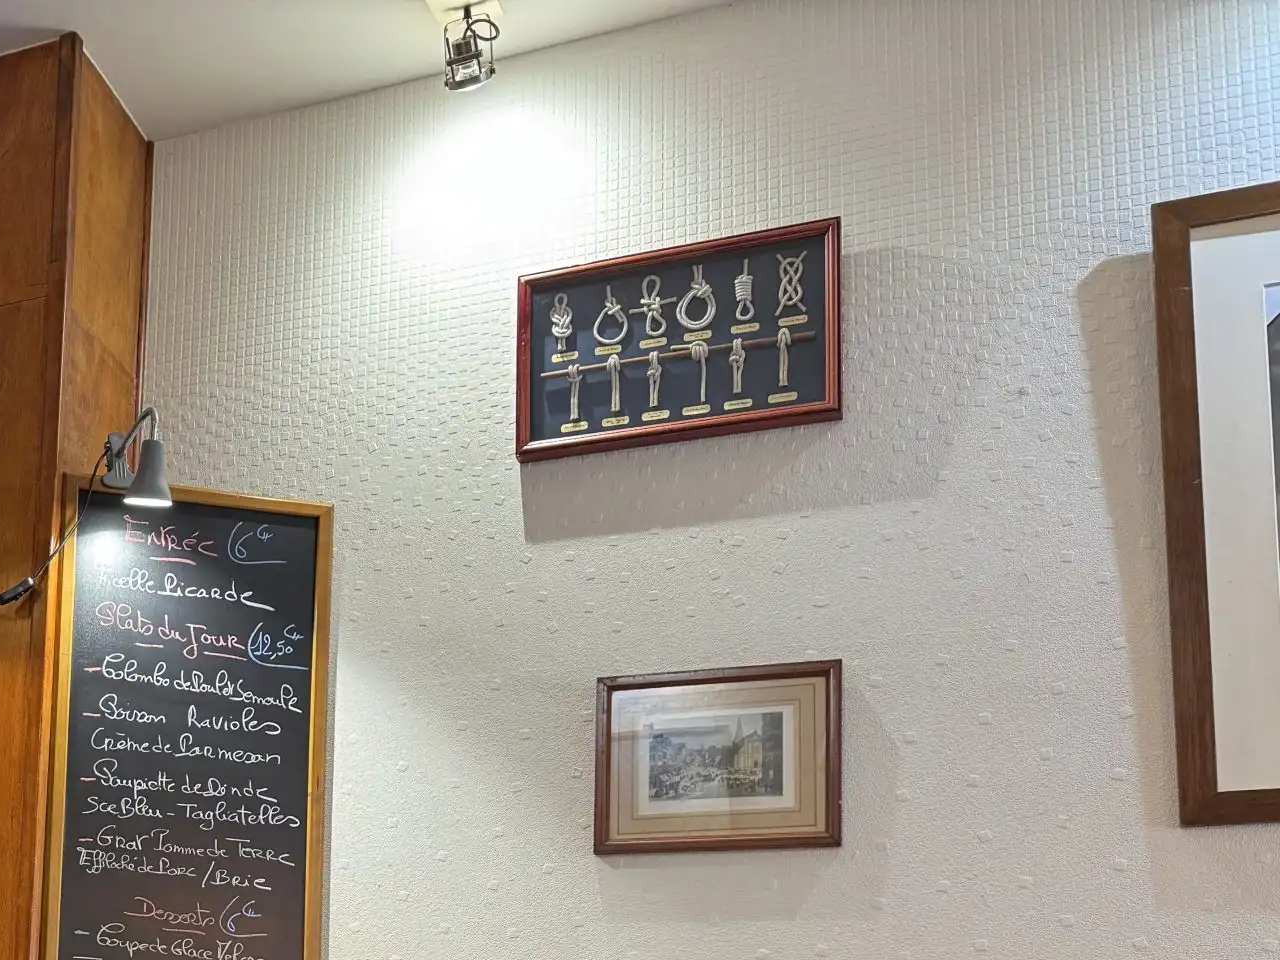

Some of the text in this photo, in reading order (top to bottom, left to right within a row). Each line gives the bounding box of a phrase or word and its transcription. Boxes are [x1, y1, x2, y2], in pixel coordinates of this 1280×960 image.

[157, 573, 276, 612] Picarde
[95, 601, 154, 636] Plats
[158, 615, 187, 643] du
[101, 652, 170, 686] Colombo
[174, 670, 191, 691] de
[229, 680, 303, 714] Semoule
[99, 693, 282, 735] Poisson Ravioles
[90, 727, 281, 765] Crème de Parmesan
[92, 757, 278, 803] Paupiette de Dinde
[120, 796, 163, 819] Bleu
[177, 801, 301, 830] Tagliatelles
[151, 828, 205, 858] Pomme
[206, 839, 230, 858] de
[138, 856, 156, 873] de
[124, 896, 215, 927] Desserts
[97, 922, 150, 958] Coupe
[149, 938, 168, 954] de
[171, 938, 213, 960] Glace
